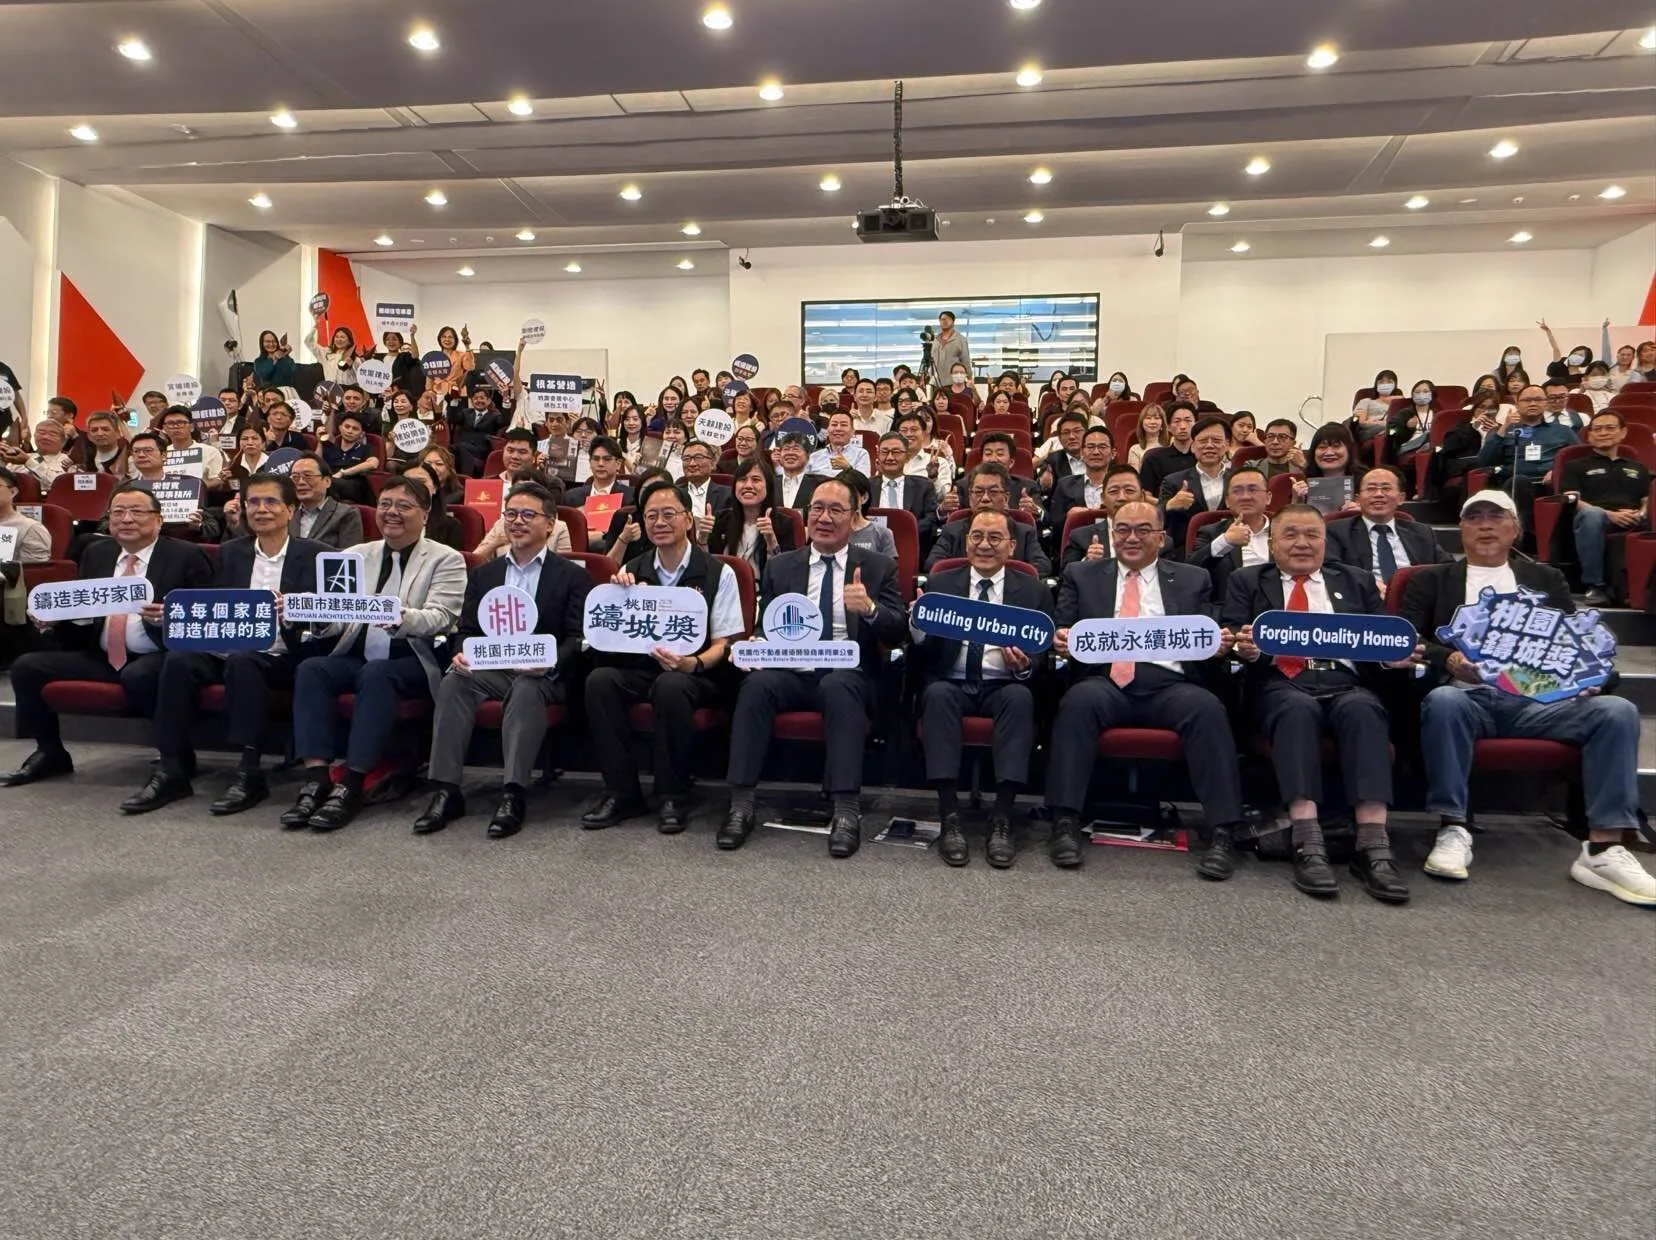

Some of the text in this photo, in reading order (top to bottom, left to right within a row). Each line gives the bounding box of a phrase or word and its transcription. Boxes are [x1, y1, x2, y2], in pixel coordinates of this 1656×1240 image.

[34, 584, 147, 611] 鑄造美好家園
[287, 597, 395, 613] 桃園市建築師公會
[623, 597, 657, 613] 桃園
[169, 602, 273, 621] 為每個家庭
[318, 613, 355, 621] ARCHITECTS
[355, 614, 395, 622] ASSOCIATION
[588, 603, 700, 643] 鑄城獎
[1490, 599, 1561, 637] 桃園
[168, 622, 272, 640] 鑄造值得的家
[918, 606, 1049, 646] Building Urban City
[1260, 625, 1410, 649] Forging Quality Homes
[473, 643, 546, 660] 桃園市政府
[1075, 627, 1215, 652] 成就永續城市
[1480, 630, 1578, 676] 鑄城獎
